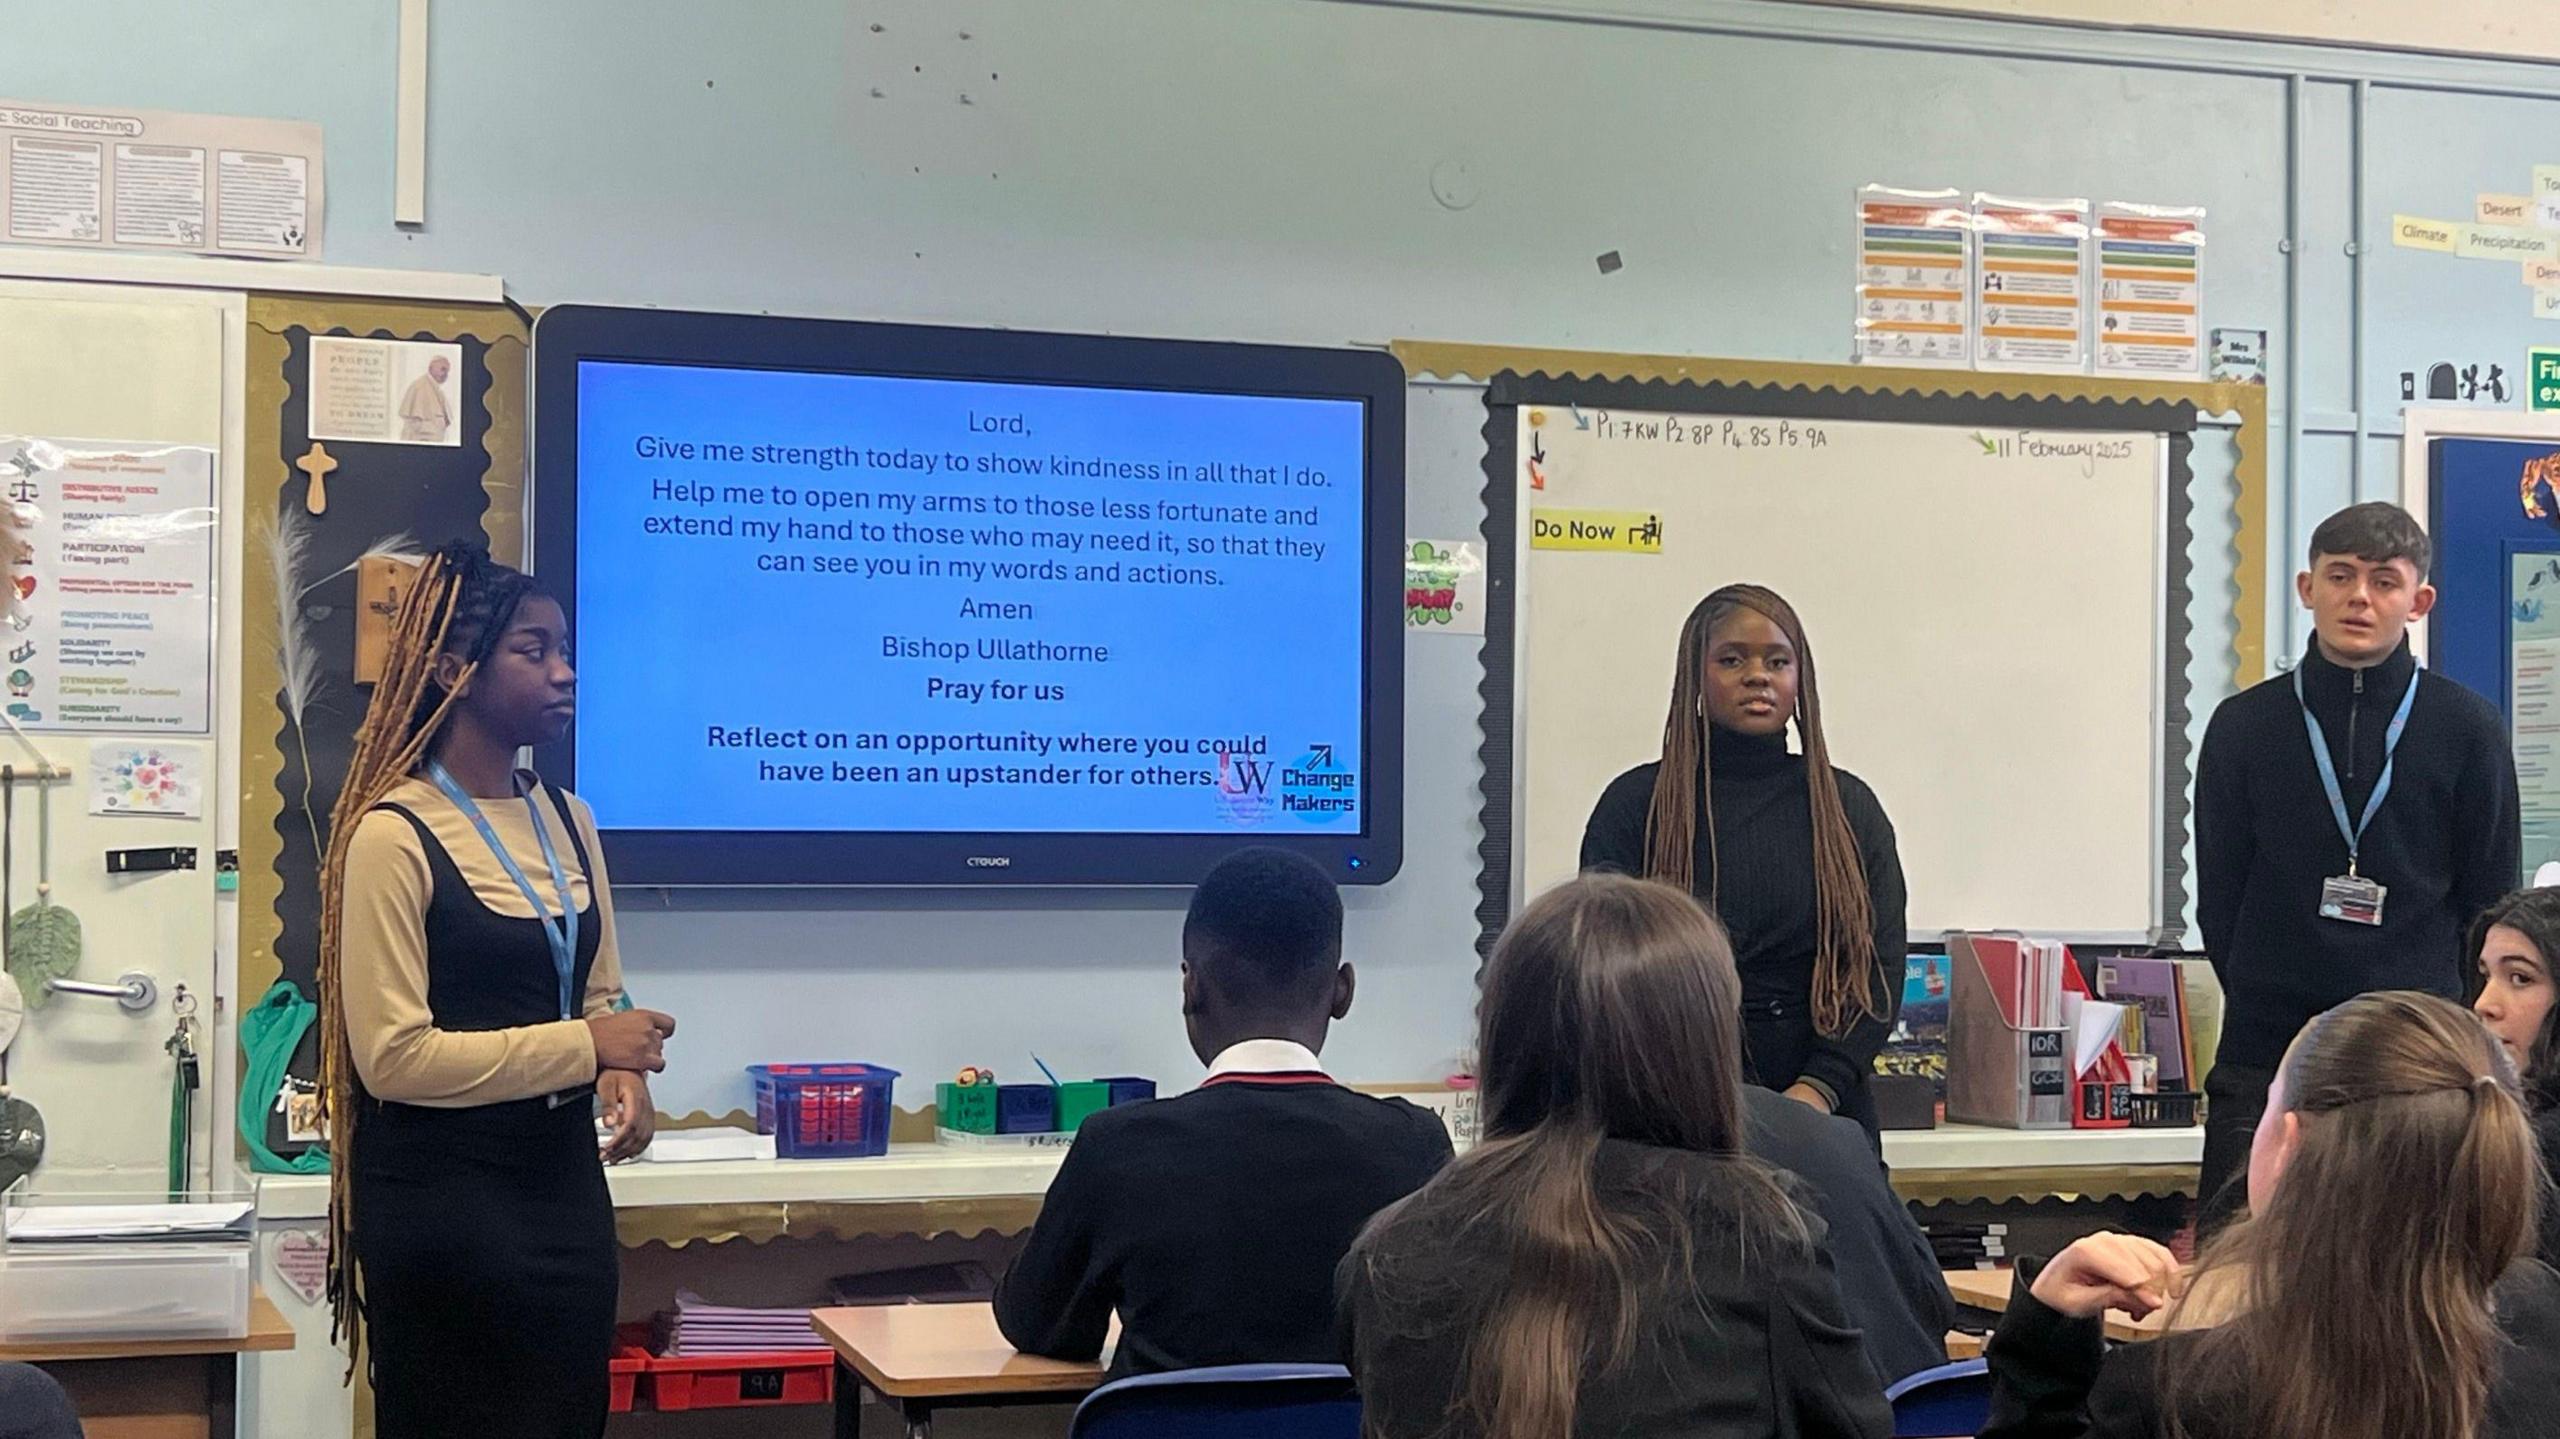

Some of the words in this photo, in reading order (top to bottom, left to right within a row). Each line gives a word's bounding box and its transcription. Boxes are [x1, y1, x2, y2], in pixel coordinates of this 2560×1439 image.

[12, 112, 58, 127] Social
[62, 116, 134, 135] Teaching
[2483, 202, 2523, 217] Desert
[2402, 225, 2448, 243] Climate
[2470, 233, 2546, 250] Precipitation
[969, 411, 1031, 436] Lord,
[637, 437, 695, 459] Give
[703, 444, 744, 462] me
[751, 444, 859, 471] strength
[867, 449, 938, 475] today
[945, 452, 969, 473] to
[977, 453, 1043, 475] show
[1050, 455, 1160, 481] kindness
[1168, 461, 1187, 481] in
[1195, 462, 1224, 483] all
[1231, 464, 1277, 485] that
[1285, 466, 1289, 486] I
[1296, 467, 1332, 487] do.
[1999, 438, 2011, 459] 11
[2018, 430, 2095, 479] February
[2095, 441, 2132, 459] 2025
[653, 478, 715, 507] Help
[723, 486, 764, 505] me
[771, 486, 797, 506] to
[805, 490, 869, 512] open
[878, 494, 916, 515] my
[923, 495, 986, 513] arms
[993, 496, 1018, 515] to
[1025, 496, 1095, 518] those
[1102, 497, 1150, 520] less
[1157, 500, 1267, 524] fortunate
[1274, 507, 1318, 526] and
[644, 516, 733, 537] extend
[742, 521, 781, 542] my
[788, 519, 852, 541] hand
[860, 522, 885, 542] to
[893, 522, 964, 546] those
[971, 526, 1024, 547] who
[1032, 532, 1084, 554] may
[1090, 531, 1150, 552] need
[1158, 532, 1180, 556] it,
[1187, 537, 1215, 554] so
[1223, 535, 1269, 556] that
[1276, 537, 1326, 562] they
[1535, 519, 1562, 538] Do
[1570, 520, 1616, 540] Now
[62, 543, 145, 554] PARTICIPATION
[757, 554, 805, 572] can
[813, 556, 858, 573] see
[865, 558, 911, 579] you
[919, 555, 940, 576] in
[949, 564, 982, 583] my
[991, 560, 1067, 581] words
[1075, 562, 1120, 583] and
[1127, 564, 1225, 587] actions.
[959, 598, 1033, 619] Amen
[883, 636, 970, 663] Bishop
[977, 638, 1109, 664] Ullathorne
[927, 678, 985, 704] Pray
[991, 679, 1028, 700] for
[1034, 683, 1065, 702] us
[708, 726, 807, 749] Reflect
[815, 732, 848, 749] on
[856, 733, 888, 750] an
[896, 730, 1052, 758] opportunity
[1058, 732, 1138, 754] where
[1144, 738, 1190, 759] you
[1198, 735, 1267, 755] could
[759, 760, 824, 782] have
[832, 760, 899, 783] been
[906, 767, 939, 783] an
[947, 763, 1082, 788] upstander
[1088, 764, 1124, 785] for
[1130, 765, 1220, 787] others.
[1282, 768, 1355, 791] Change
[1282, 794, 1355, 812] Makers
[966, 857, 1010, 867] CTOUCH
